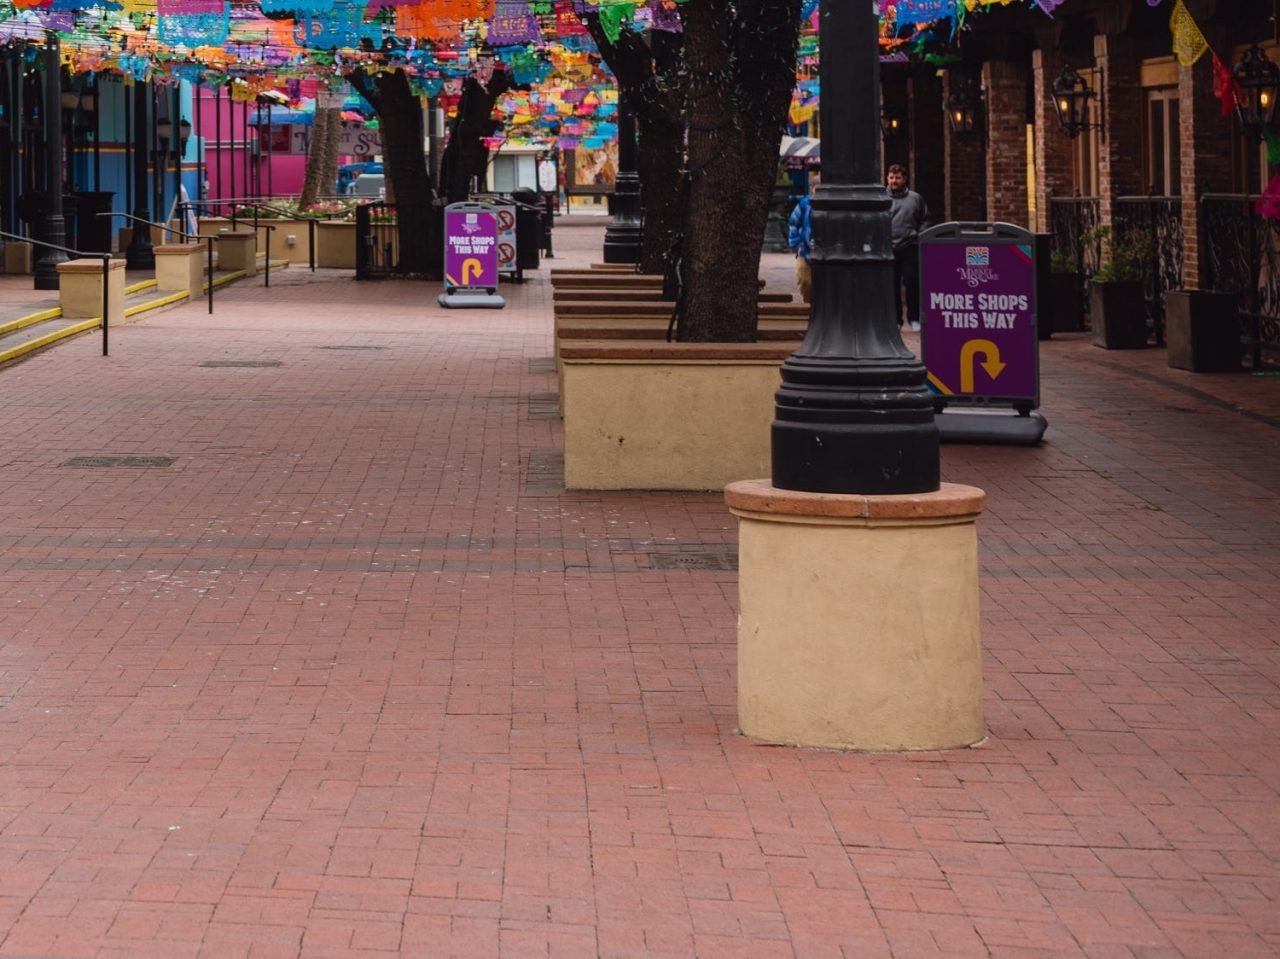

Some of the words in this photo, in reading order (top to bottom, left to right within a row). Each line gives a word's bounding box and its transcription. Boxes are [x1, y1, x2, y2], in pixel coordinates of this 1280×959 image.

[449, 236, 469, 245] MORE
[471, 236, 494, 246] SHOPS
[454, 245, 472, 254] THIS
[473, 245, 489, 254] WAY
[930, 292, 974, 310] MORE
[978, 293, 1029, 311] SHOPS
[942, 311, 978, 329] THIS
[981, 312, 1016, 329] WAY
